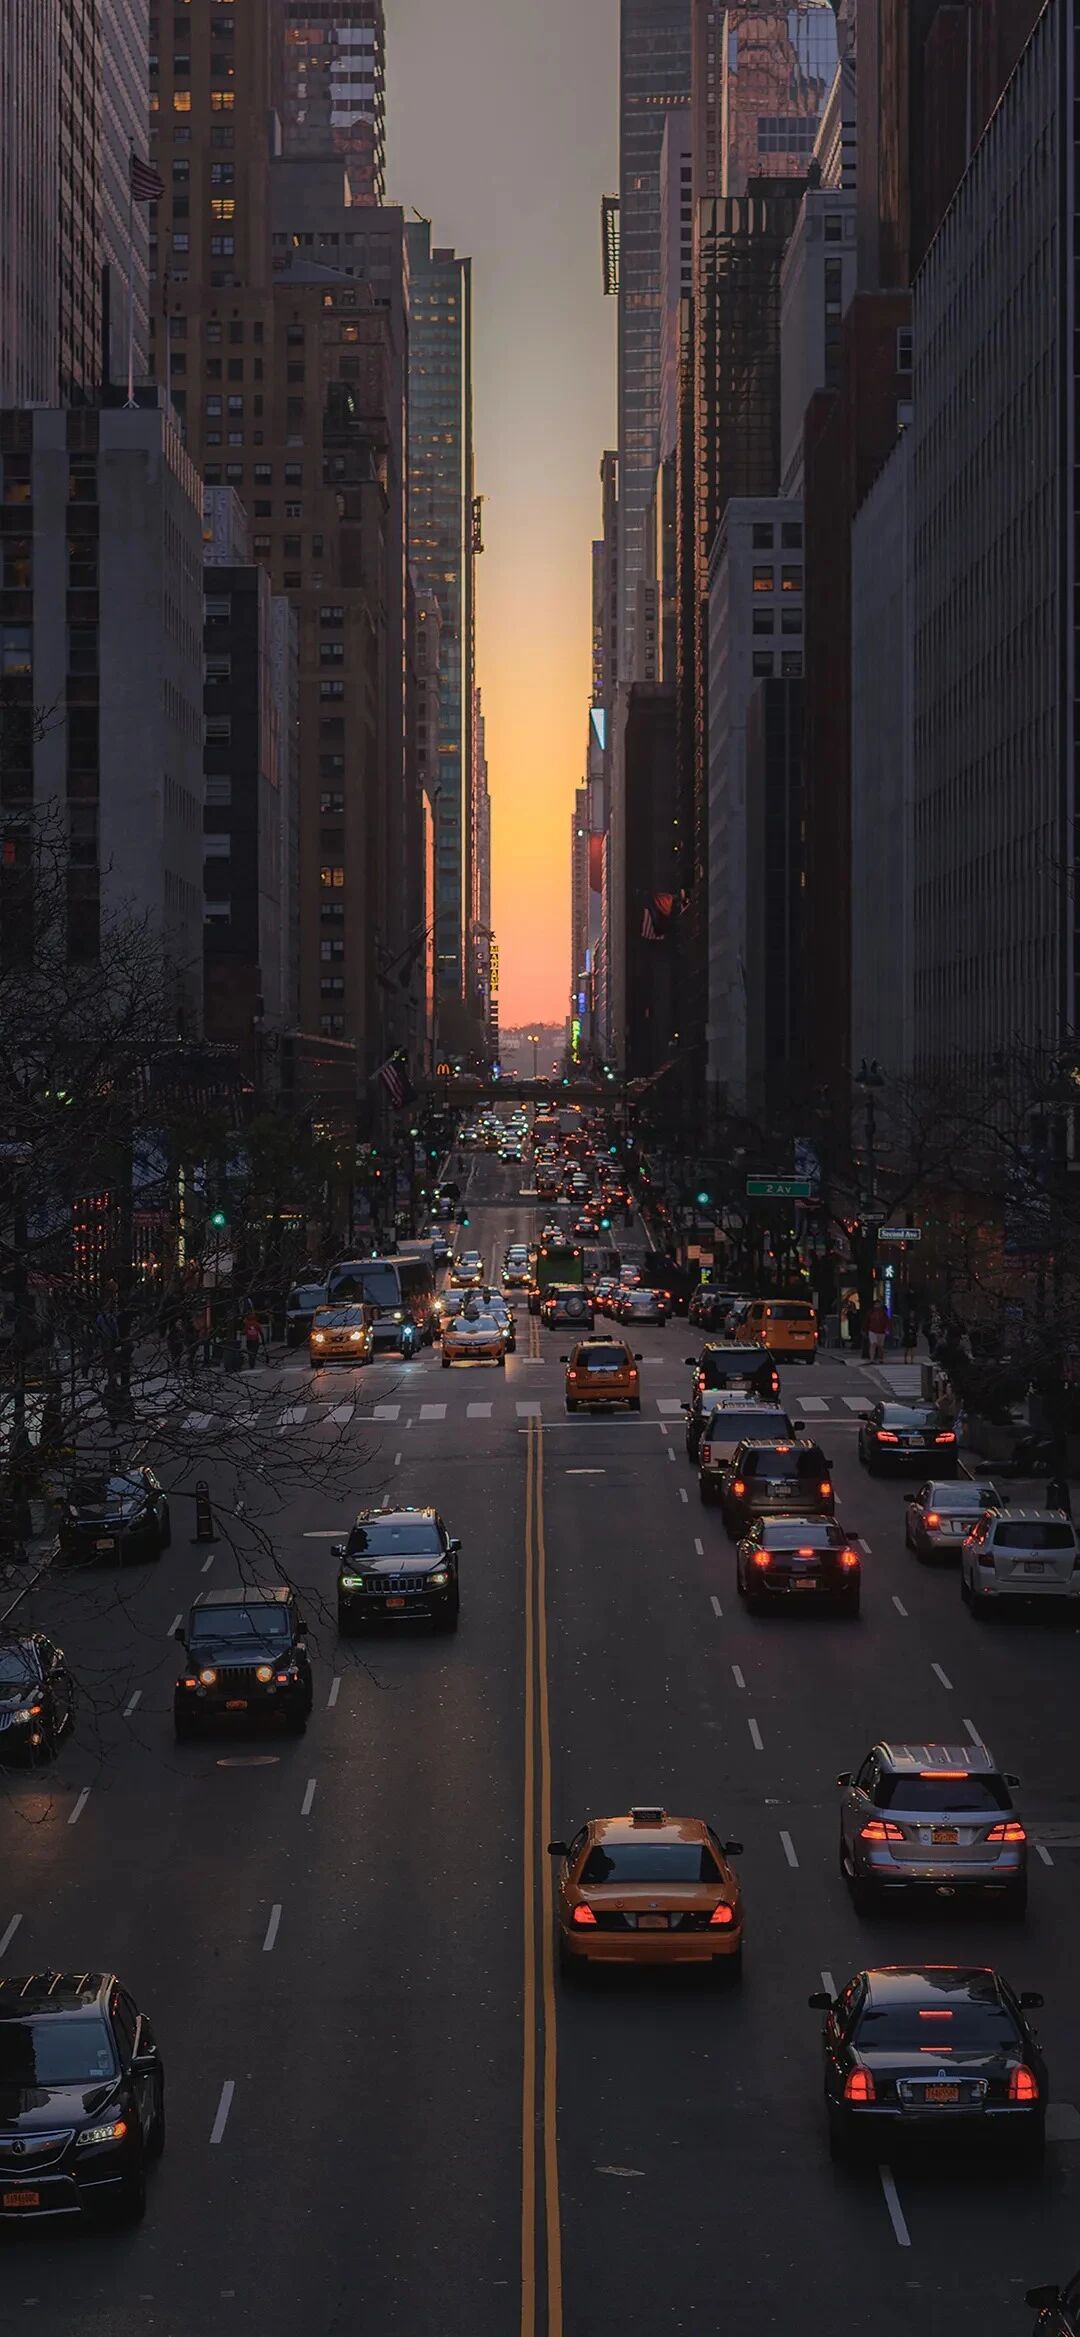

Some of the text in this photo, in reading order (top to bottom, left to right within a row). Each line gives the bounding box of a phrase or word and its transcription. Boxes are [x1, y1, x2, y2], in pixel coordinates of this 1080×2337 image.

[766, 1184, 791, 1193] 2 Av
[881, 1230, 905, 1238] Second
